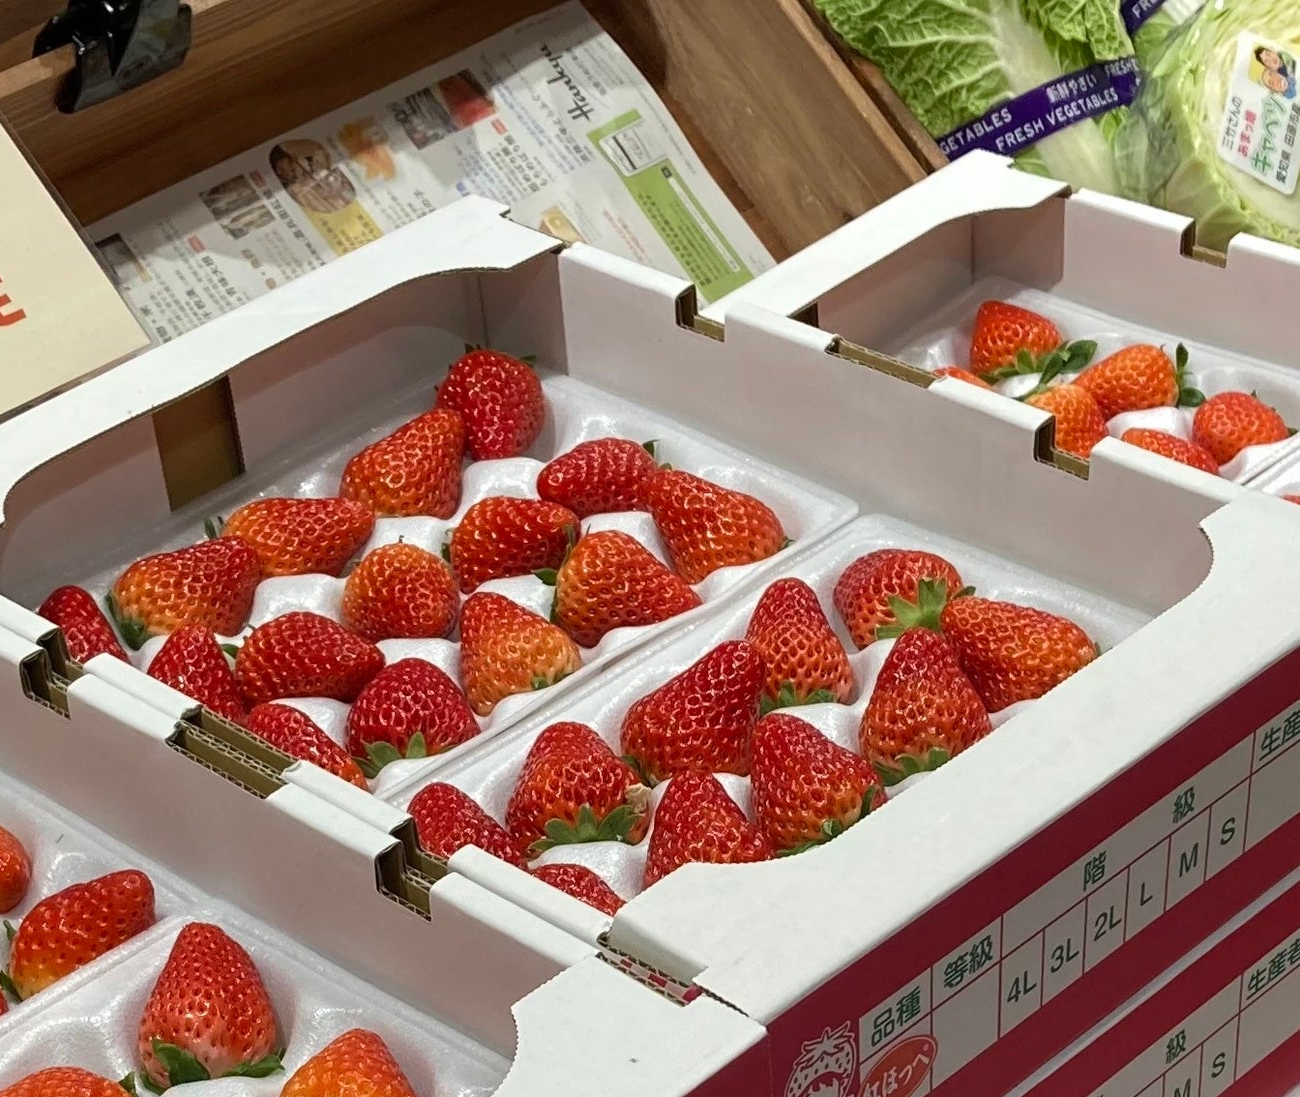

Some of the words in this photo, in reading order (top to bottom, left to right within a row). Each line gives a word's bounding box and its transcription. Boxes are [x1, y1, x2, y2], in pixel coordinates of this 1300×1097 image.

[540, 42, 593, 122] Hankyu
[939, 107, 1013, 155] GETABLES
[995, 117, 1045, 154] FRESH
[1046, 87, 1119, 126] VEGETABLES
[1250, 94, 1288, 176] キャベツ
[870, 985, 923, 1044] 品種
[943, 935, 994, 989] 等級
[1082, 850, 1106, 891] 階
[1171, 787, 1196, 823] 級
[1006, 969, 1035, 1003] 4L
[1050, 938, 1080, 973] 3L
[1093, 906, 1123, 939] 2L
[1138, 880, 1153, 905] L
[1178, 844, 1200, 878] M
[1220, 820, 1235, 844] S
[1164, 1030, 1186, 1065] 級
[1210, 1053, 1226, 1077] S
